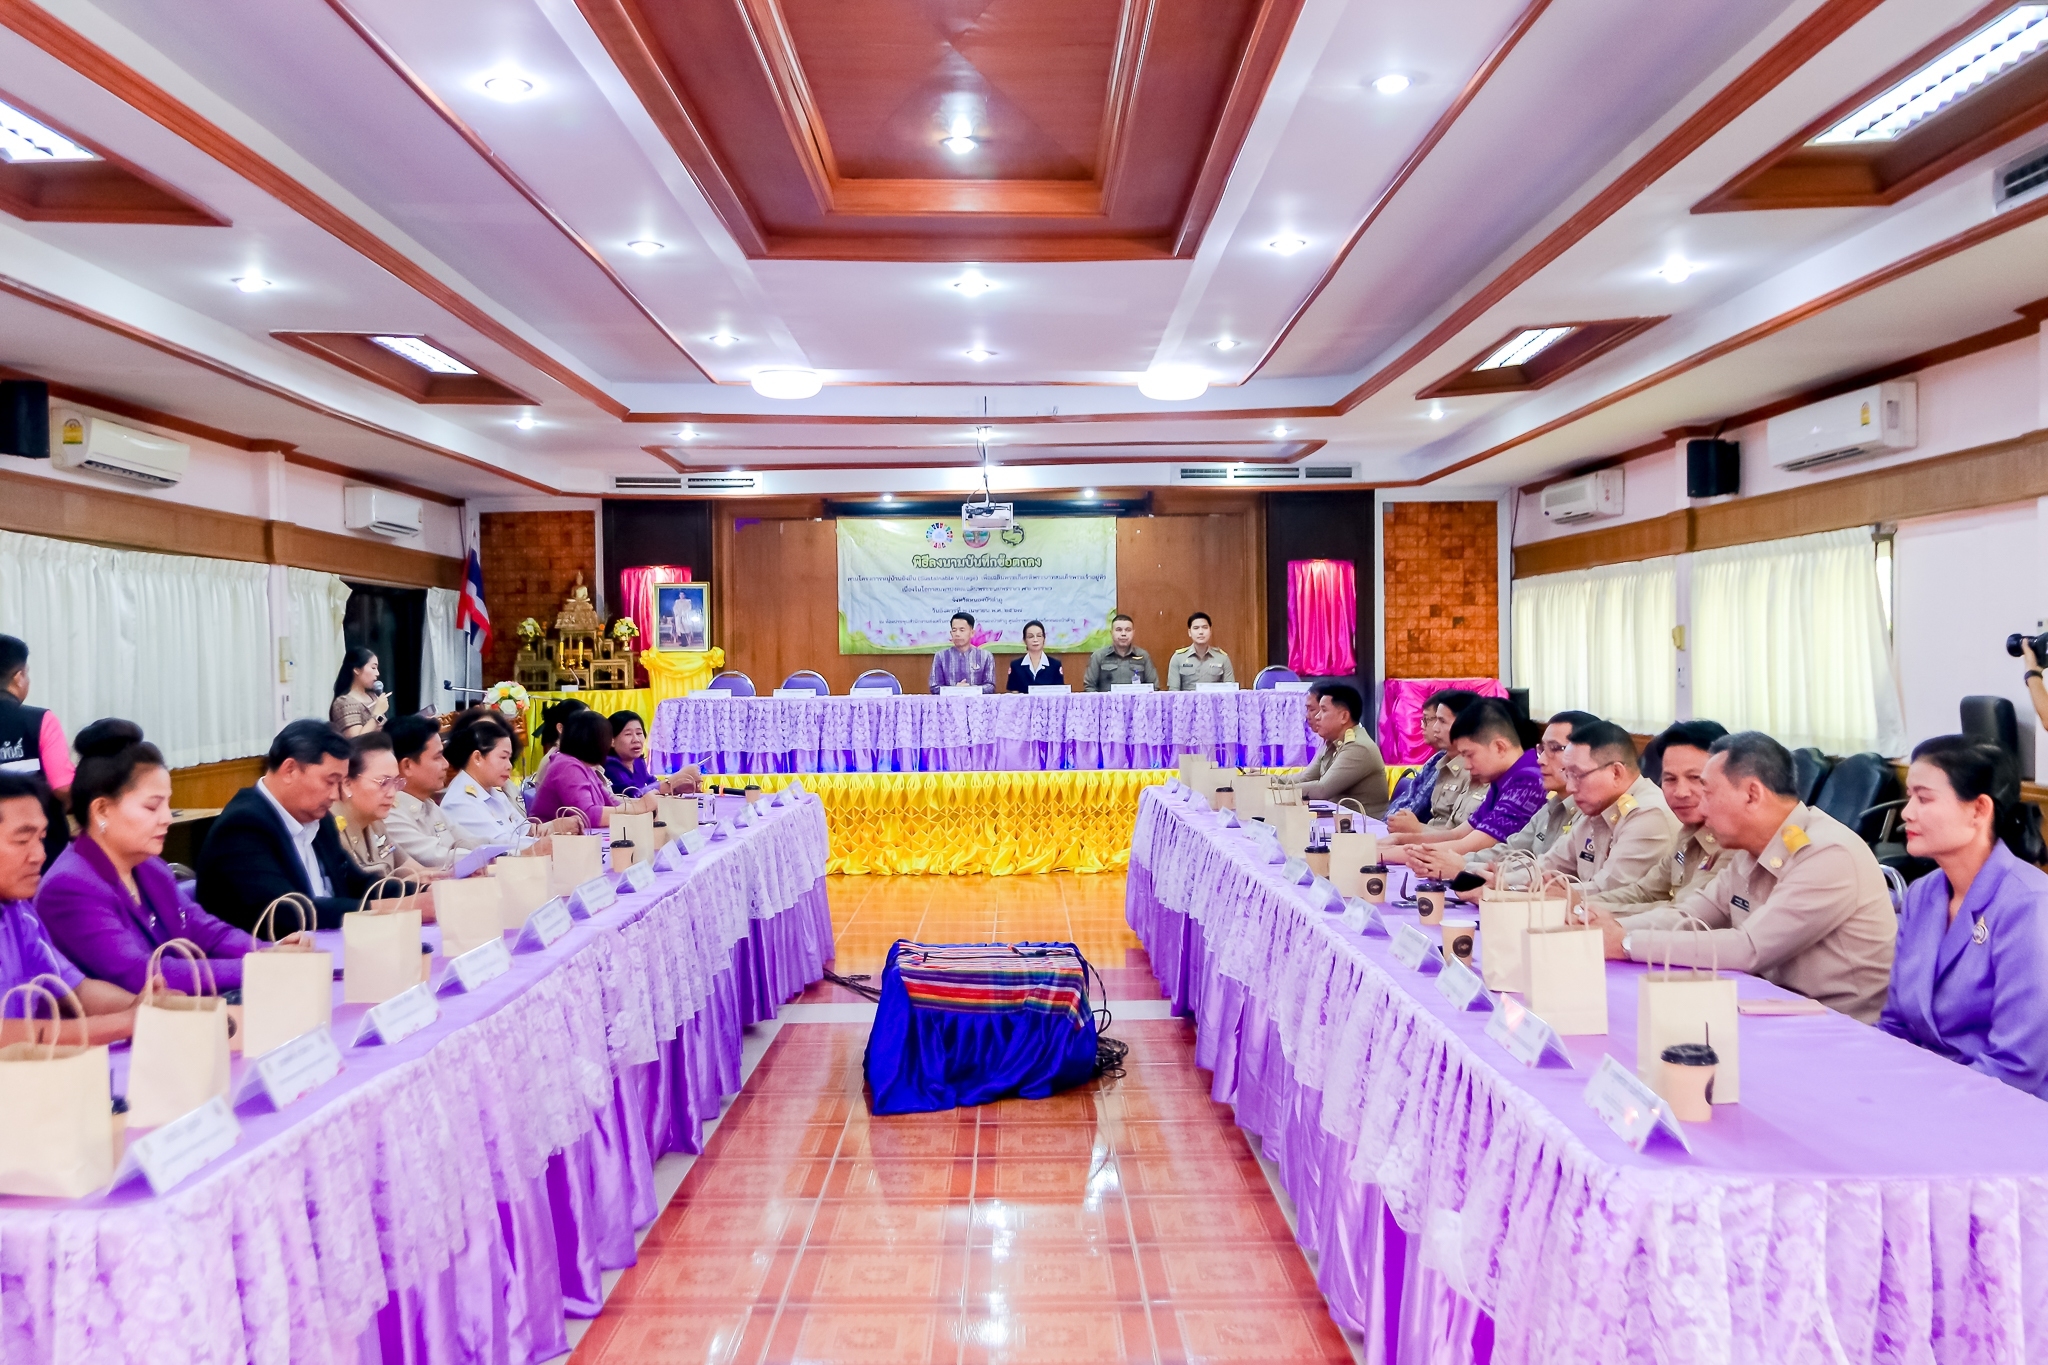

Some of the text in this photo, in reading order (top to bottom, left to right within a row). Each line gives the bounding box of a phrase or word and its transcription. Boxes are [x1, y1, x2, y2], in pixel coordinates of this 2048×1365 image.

[912, 553, 1042, 568] พิธีลงนามบันทึกข้อตกลง
